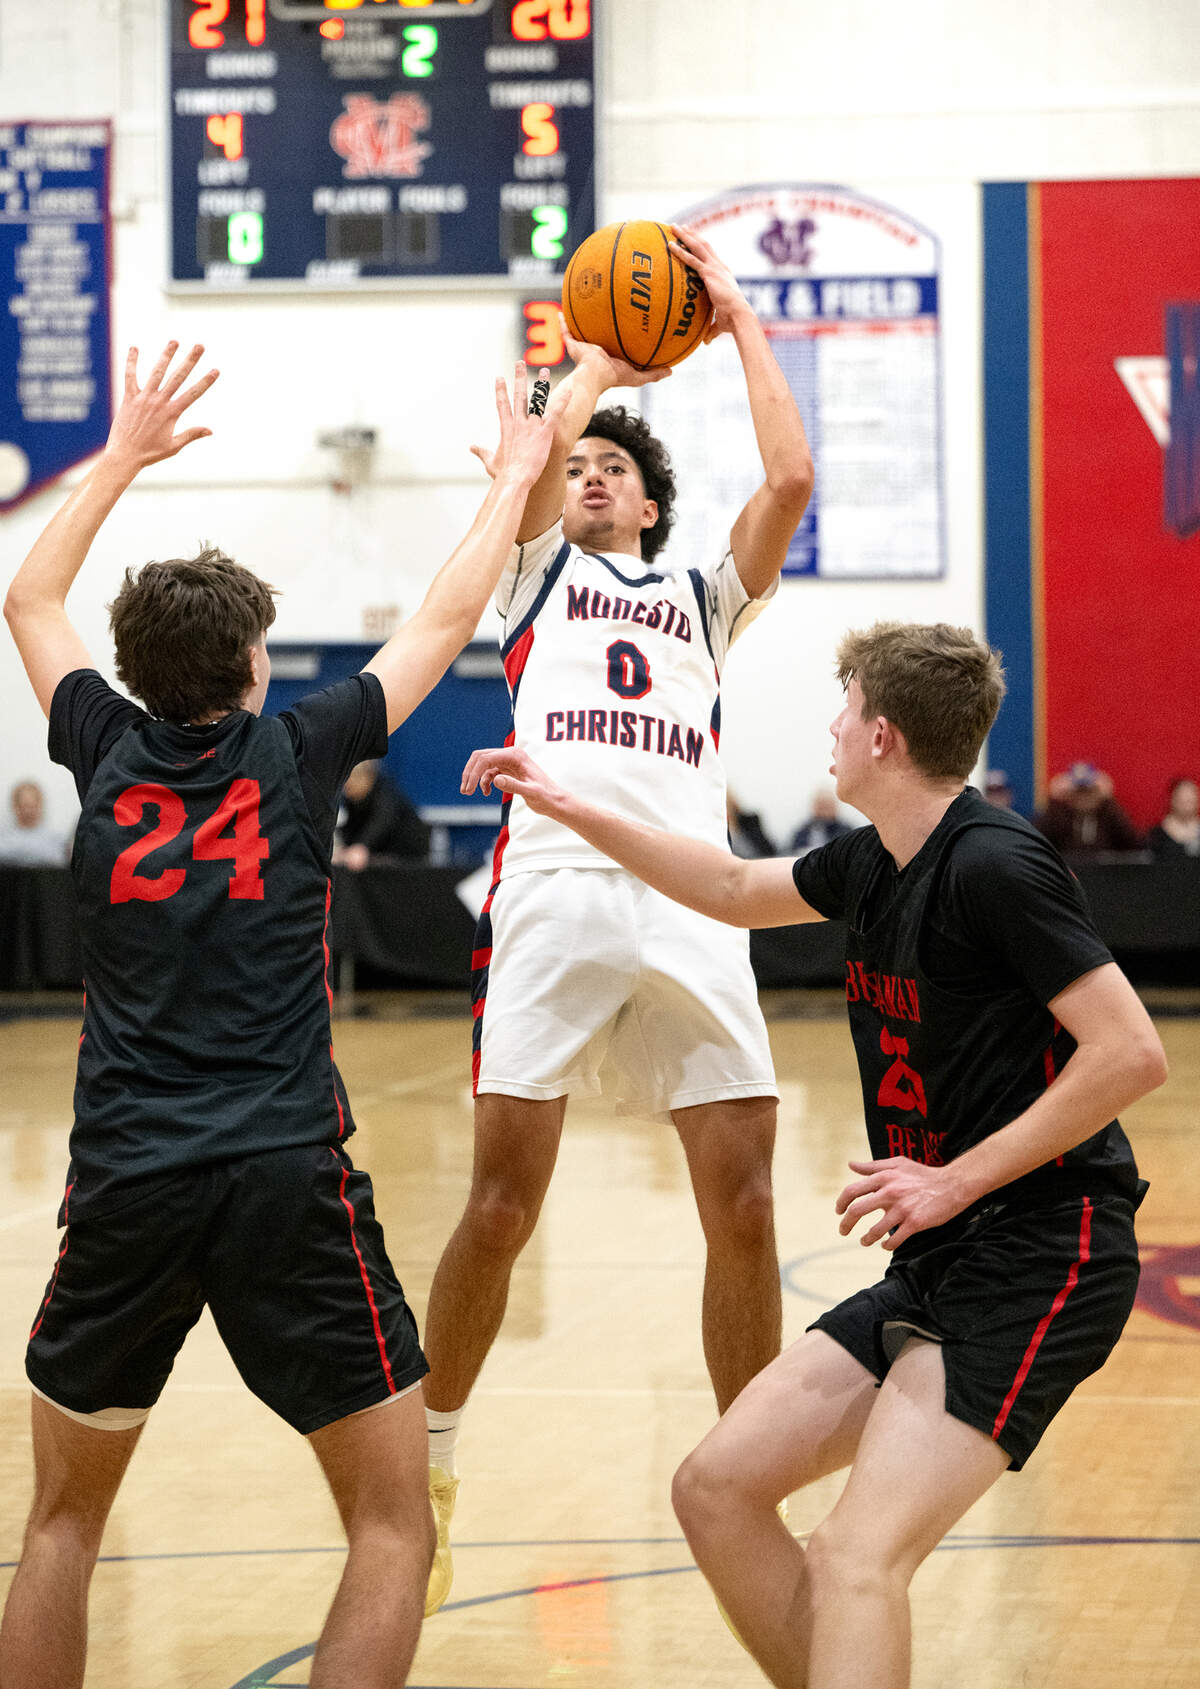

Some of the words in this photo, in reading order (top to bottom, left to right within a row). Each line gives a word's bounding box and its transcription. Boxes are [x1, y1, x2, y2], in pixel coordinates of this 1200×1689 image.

[401, 25, 438, 77] 2
[206, 112, 243, 160] 4
[521, 103, 559, 156] 5
[228, 211, 263, 264] 0
[531, 205, 568, 259] 2
[630, 250, 653, 312] EVO
[672, 236, 706, 338] lson
[523, 301, 566, 366] 3
[567, 584, 692, 644] MODESTO
[606, 639, 652, 700] 0
[545, 709, 705, 769] CHRISTIAN
[110, 778, 270, 905] 24
